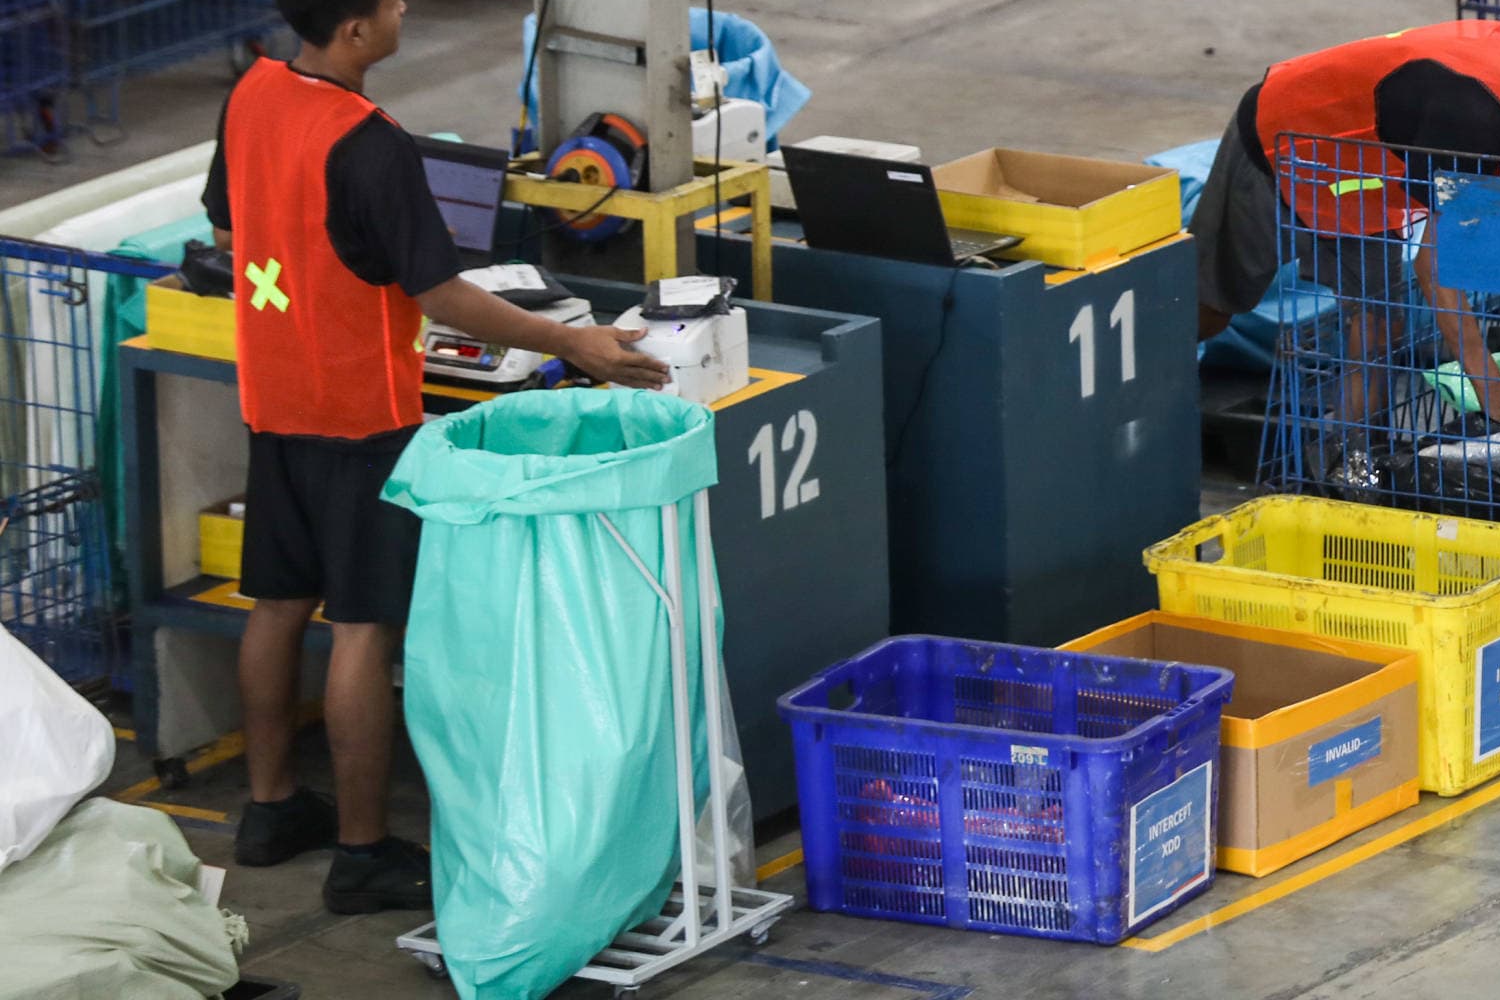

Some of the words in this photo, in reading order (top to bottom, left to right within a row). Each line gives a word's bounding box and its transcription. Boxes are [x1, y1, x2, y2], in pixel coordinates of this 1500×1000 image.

[1068, 288, 1136, 399] 11
[747, 409, 821, 520] 12
[1325, 737, 1361, 763] INVALID
[1148, 801, 1193, 842] INTERCEPT
[1161, 835, 1181, 859] XDD
